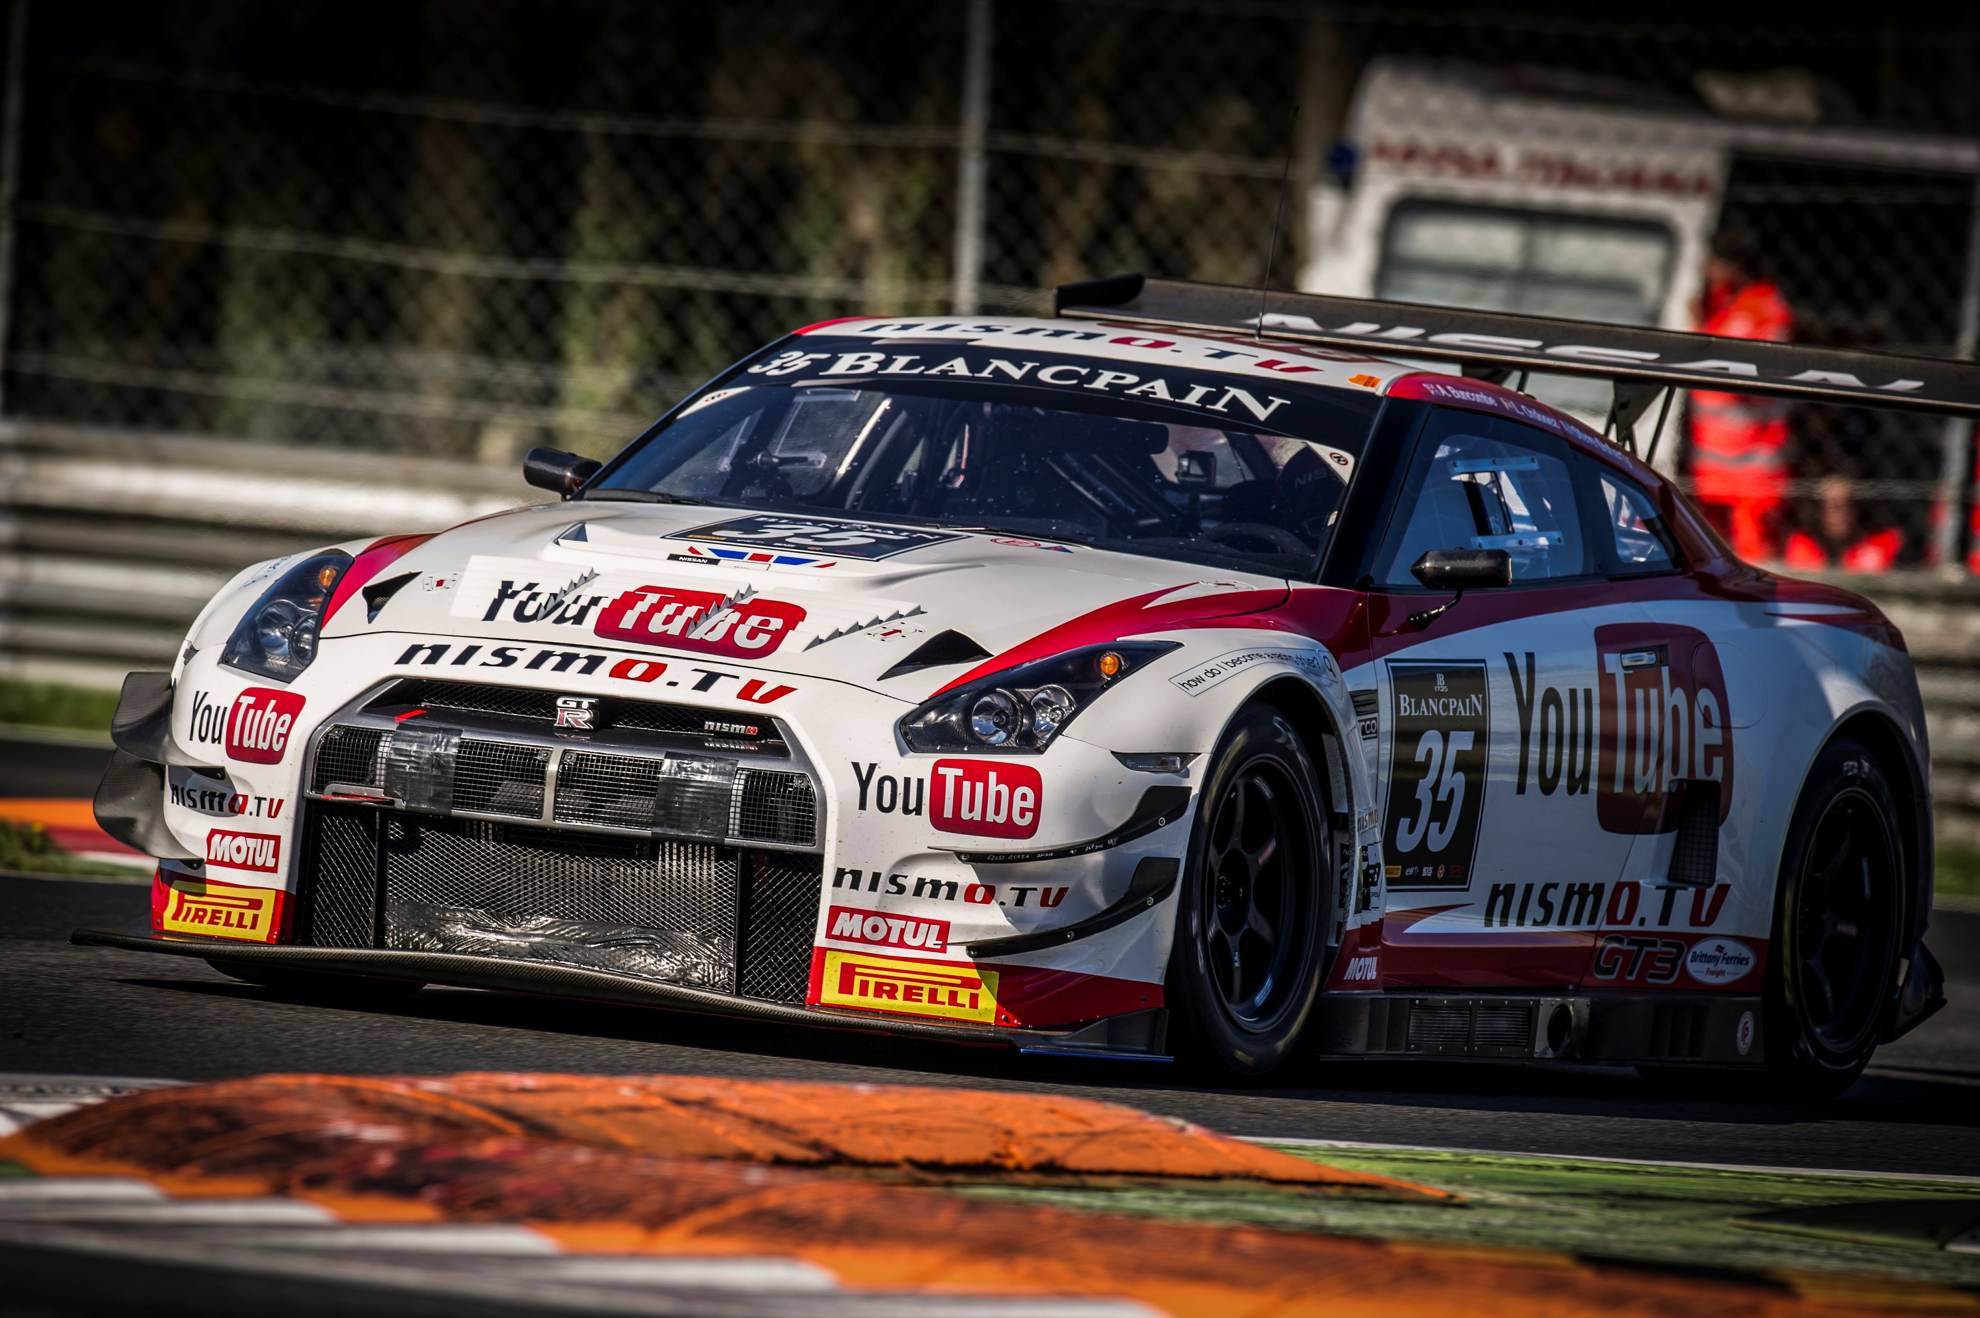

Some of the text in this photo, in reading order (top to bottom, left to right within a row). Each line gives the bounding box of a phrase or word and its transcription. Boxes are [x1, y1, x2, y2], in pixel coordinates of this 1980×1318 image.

[746, 350, 1291, 421] 35 BLANCPAIN
[711, 523, 909, 547] 35
[678, 556, 708, 564] NISSAN
[1177, 674, 1206, 691] how
[1204, 667, 1222, 679] do
[1399, 694, 1483, 717] BLANCPAIN
[704, 721, 758, 735] nismo
[1396, 730, 1475, 853] 35
[207, 834, 277, 868] MOTUL
[171, 891, 264, 931] PIRELLI
[831, 911, 944, 949] MOTUL
[1343, 955, 1378, 981] MOTUL
[1593, 934, 1688, 984] GT3
[1690, 950, 1750, 967] Brittany Ferries
[838, 961, 983, 1010] PIRELLI
